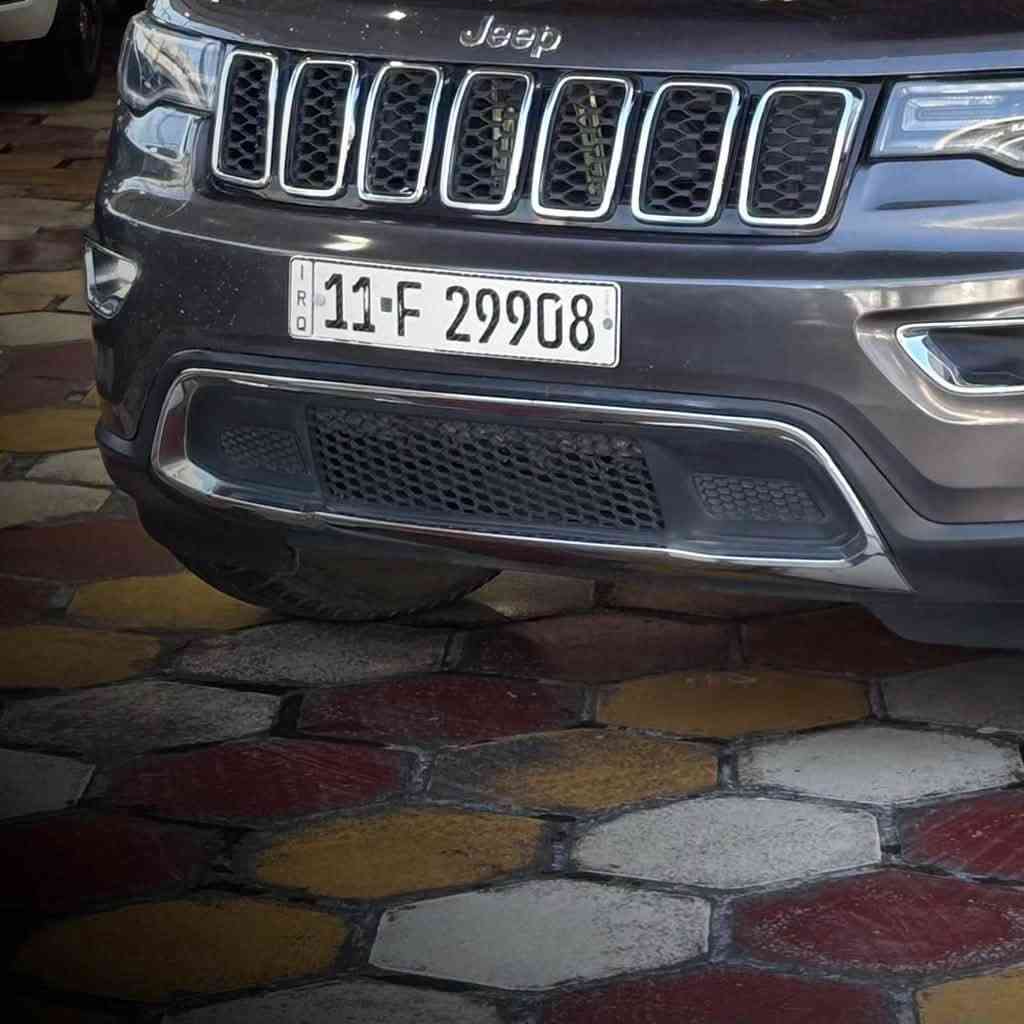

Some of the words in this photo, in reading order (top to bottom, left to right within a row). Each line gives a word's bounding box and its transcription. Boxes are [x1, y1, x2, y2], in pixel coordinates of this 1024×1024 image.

[458, 14, 562, 59] Jeep
[323, 272, 376, 334] 11
[396, 280, 423, 337] F
[445, 284, 597, 353] 29908
